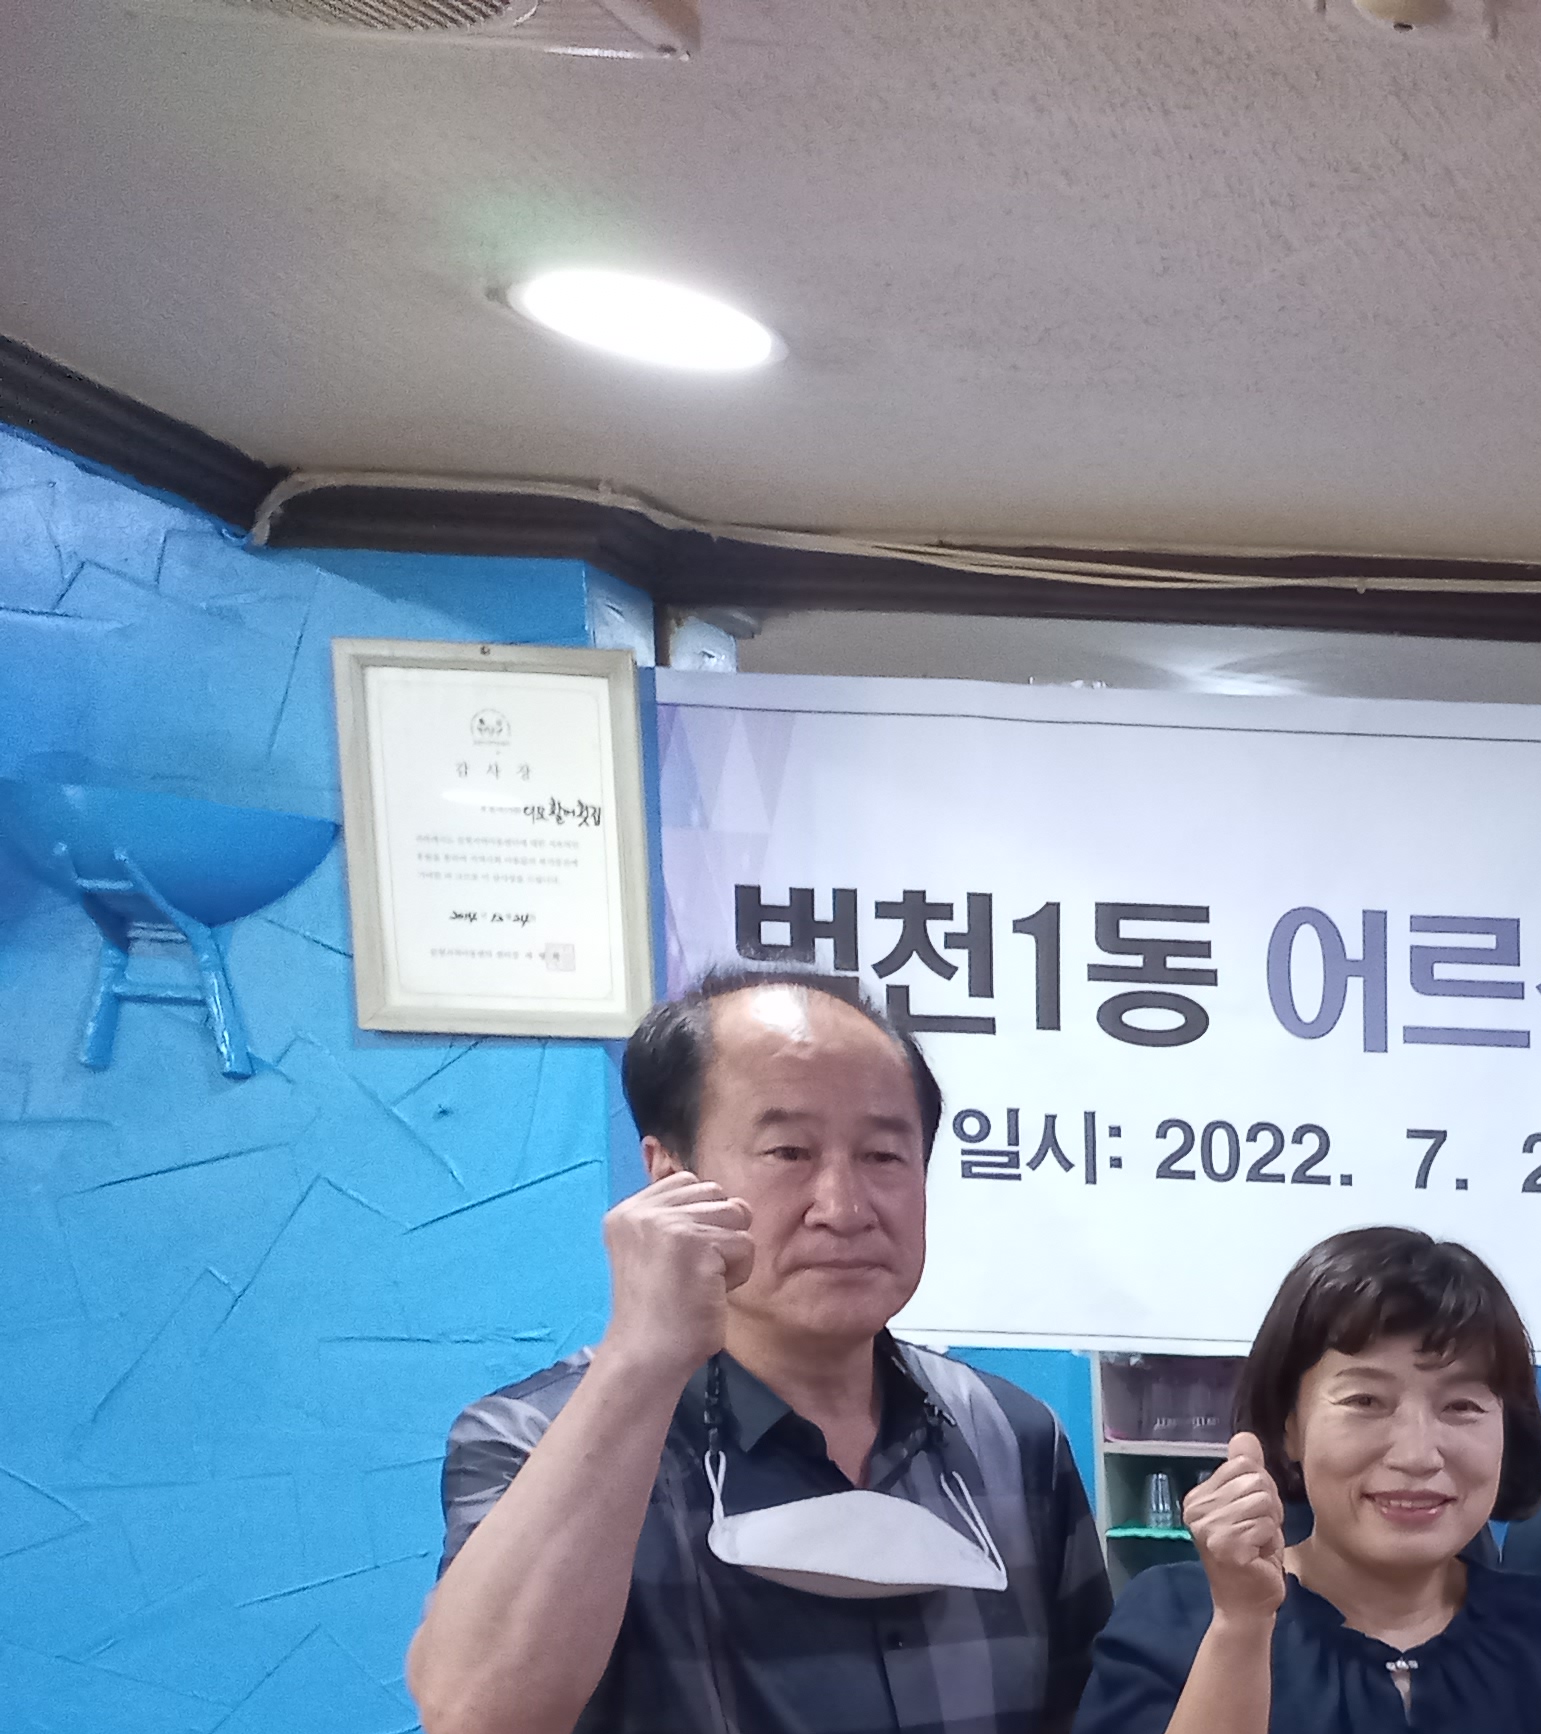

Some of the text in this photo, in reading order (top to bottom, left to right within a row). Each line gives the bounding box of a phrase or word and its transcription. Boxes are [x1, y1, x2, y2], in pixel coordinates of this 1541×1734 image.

[734, 883, 1218, 1047] 범천1동
[952, 1107, 1123, 1186] 일시:
[1154, 1117, 1354, 1188] 2022.
[1404, 1129, 1468, 1192] 7.
